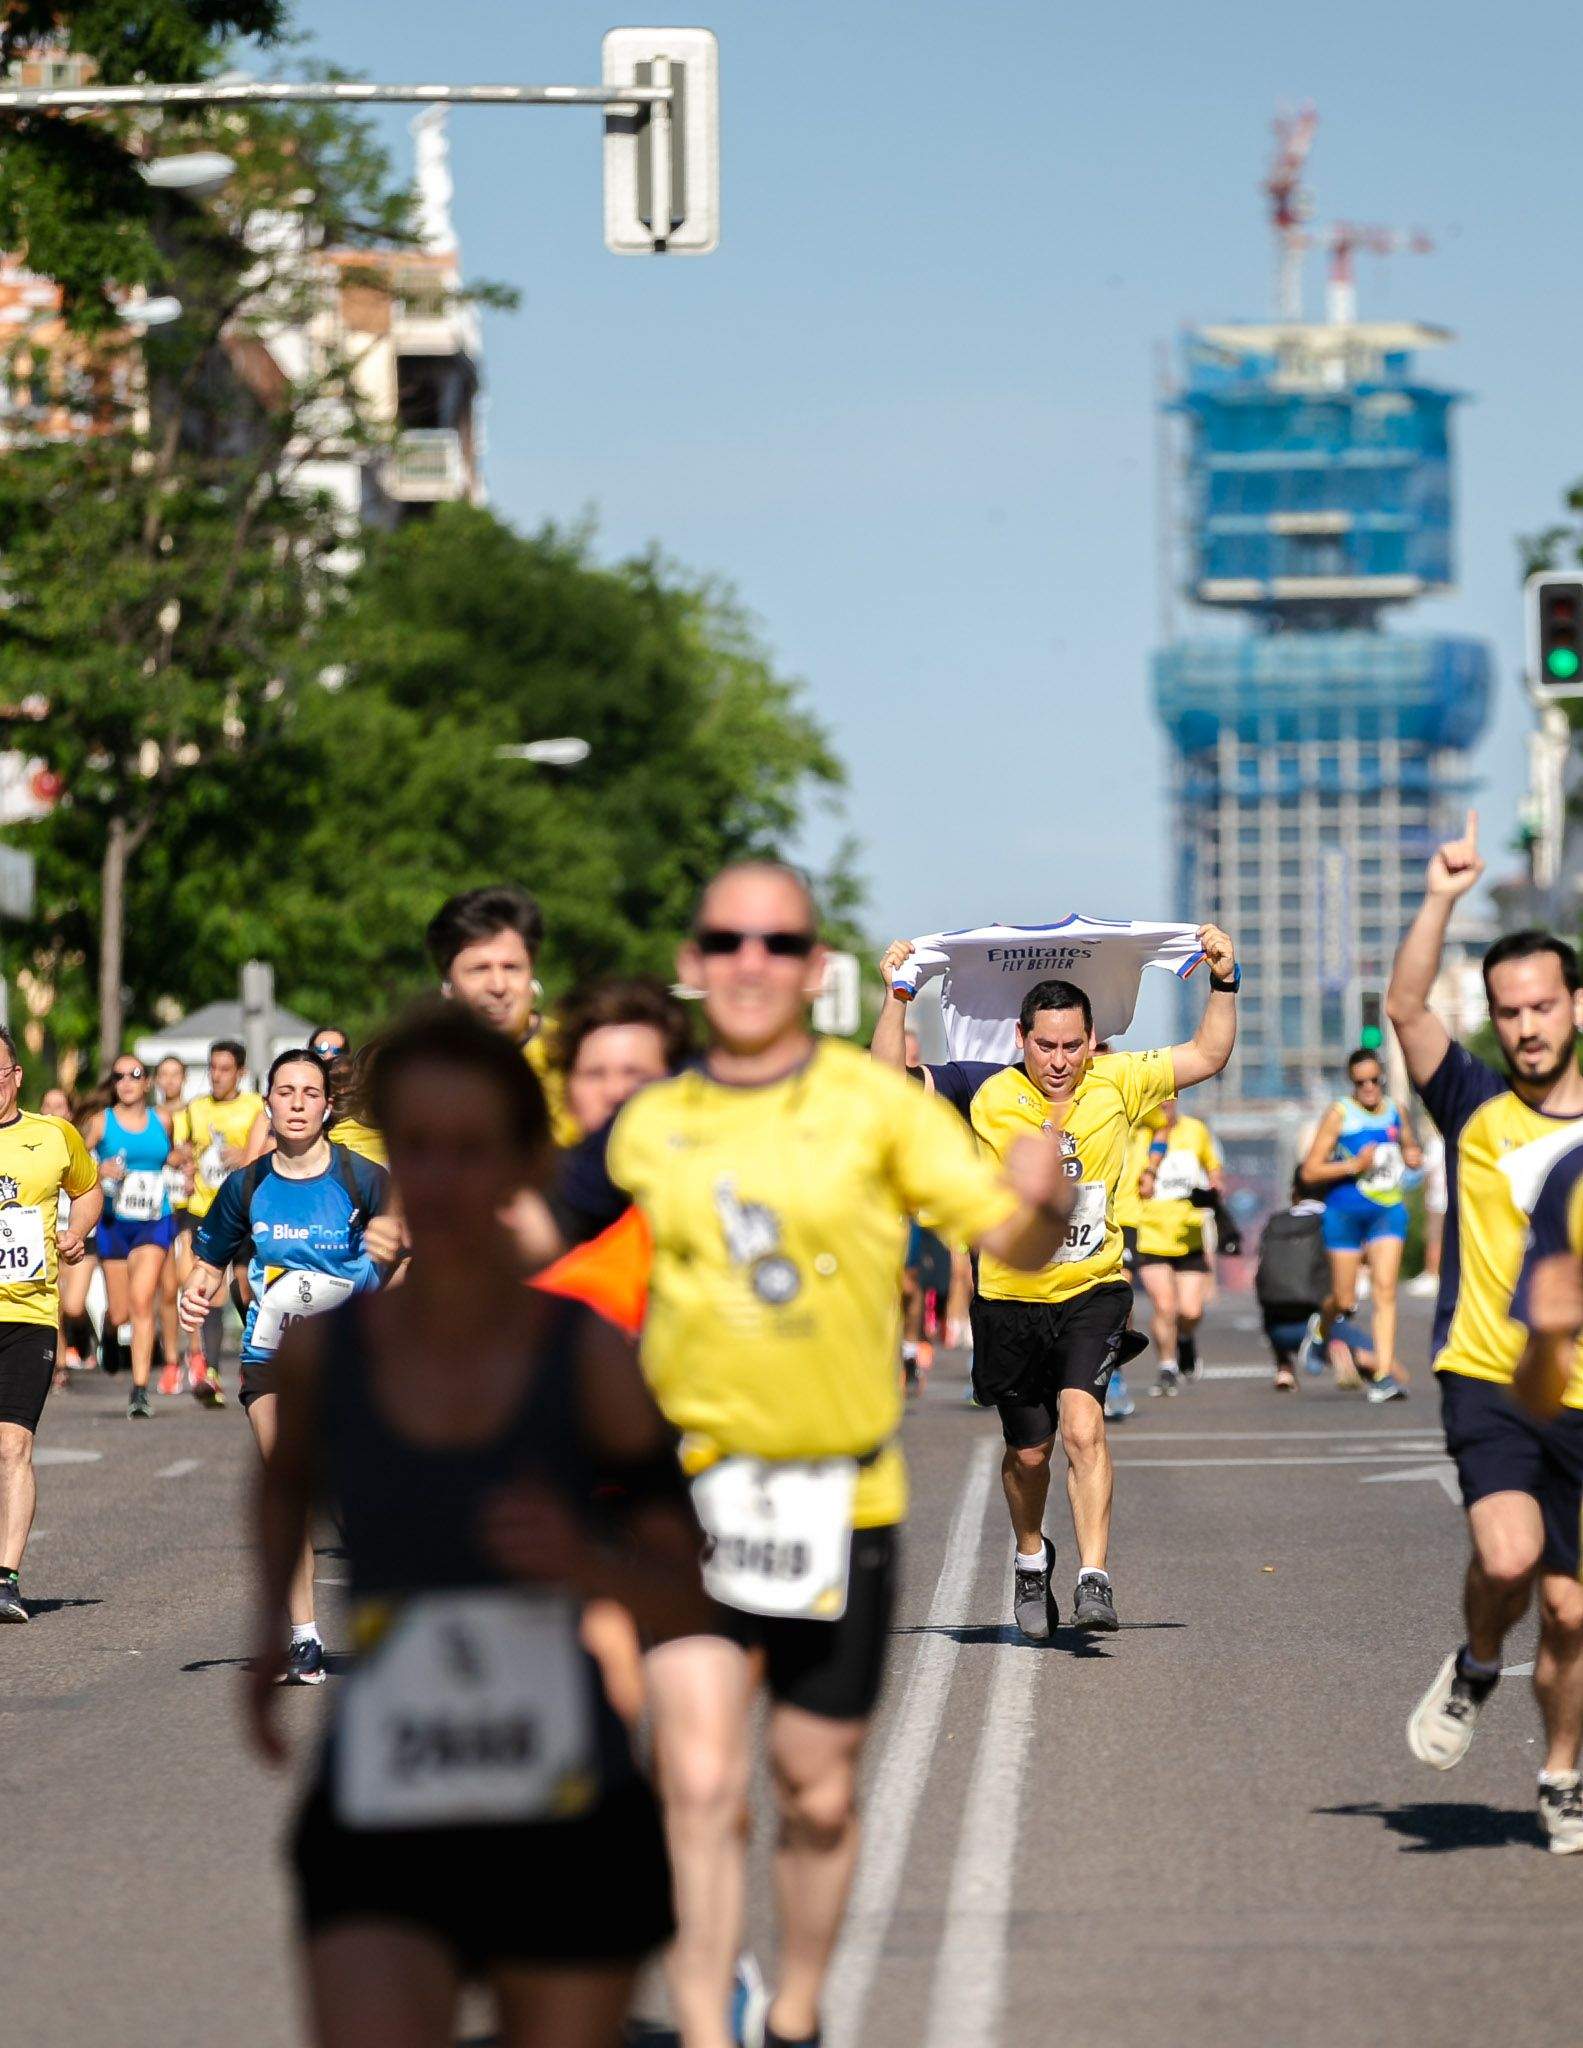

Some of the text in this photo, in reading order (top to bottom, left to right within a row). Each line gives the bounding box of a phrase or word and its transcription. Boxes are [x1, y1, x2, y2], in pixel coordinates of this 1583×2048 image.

[987, 946, 1092, 962] Emirates
[1003, 958, 1074, 972] FLY BETTER
[1062, 1162, 1078, 1178] 13
